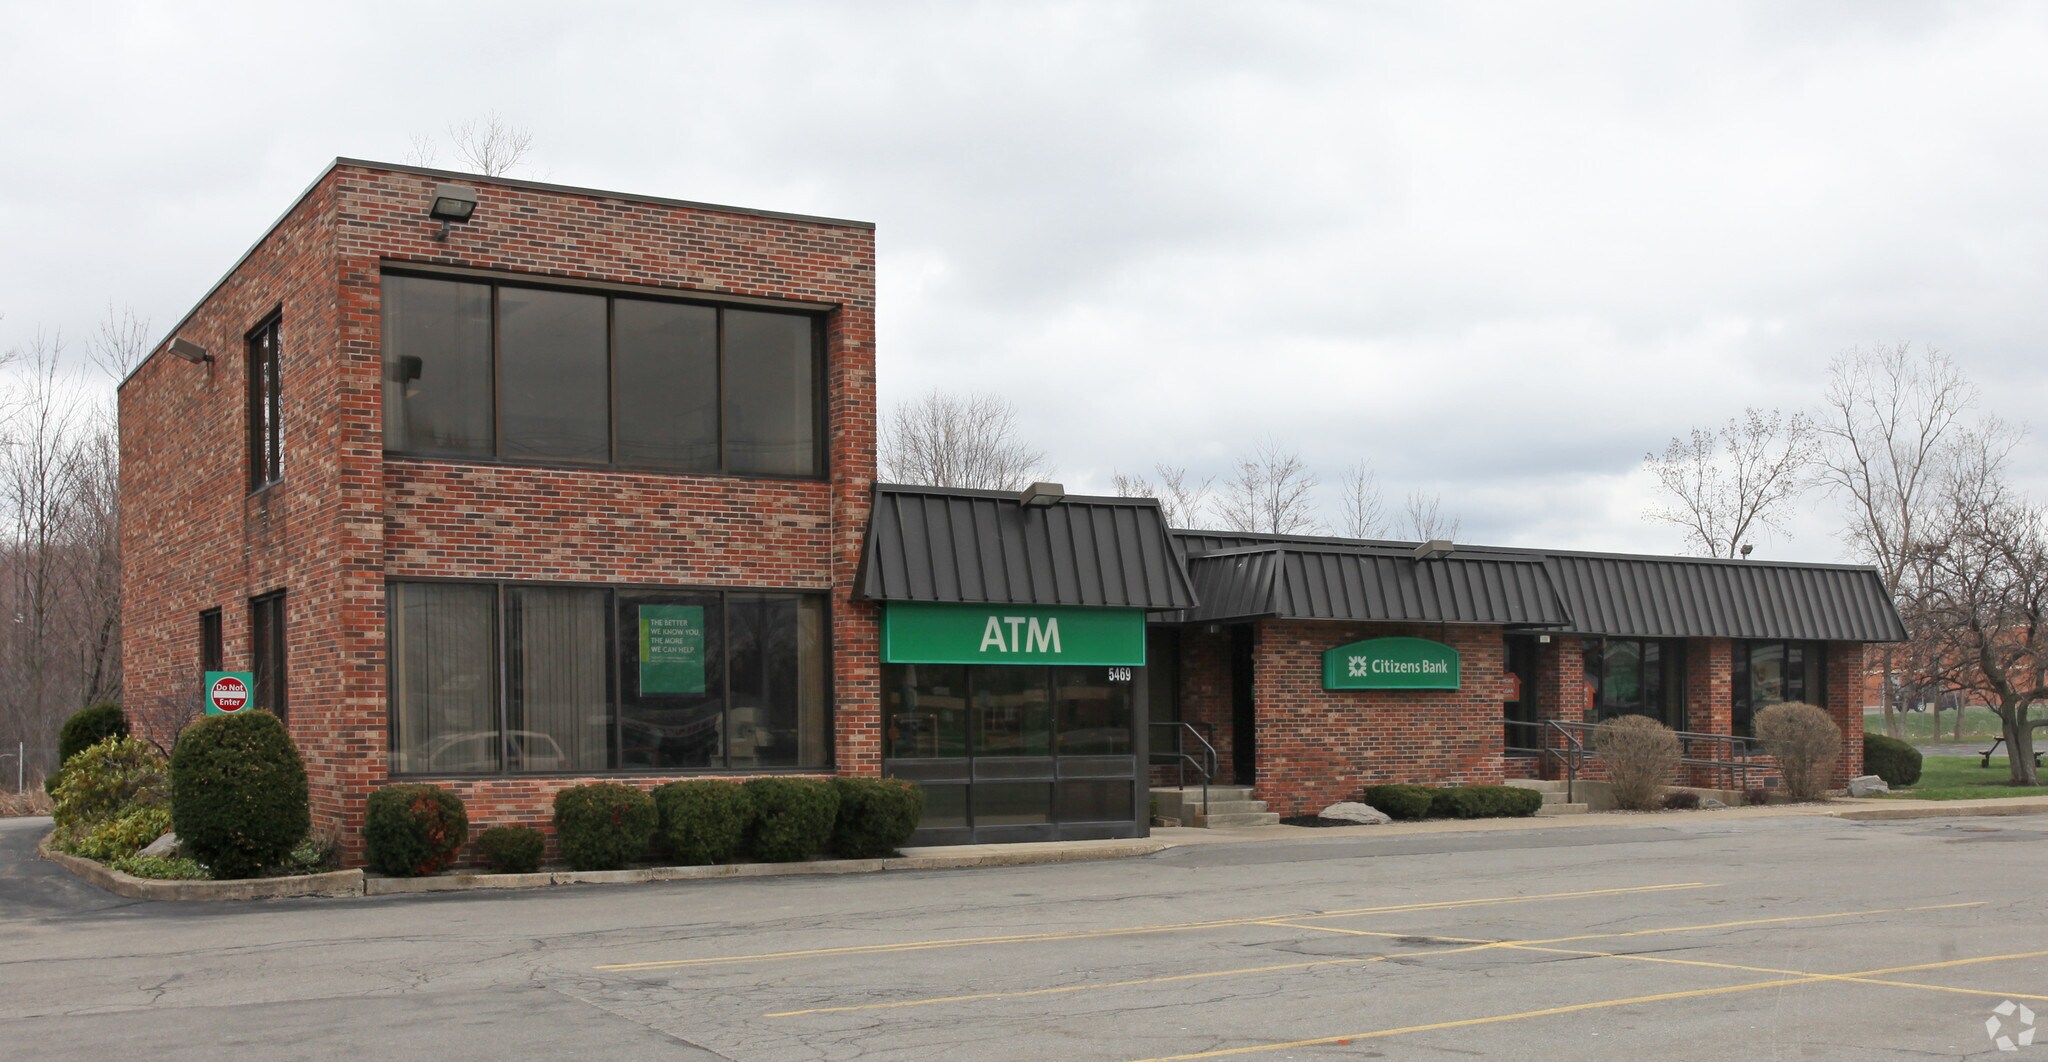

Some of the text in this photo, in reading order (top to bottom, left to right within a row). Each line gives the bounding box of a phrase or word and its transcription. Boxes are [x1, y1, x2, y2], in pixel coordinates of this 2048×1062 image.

[664, 619, 688, 627] BETTER
[662, 628, 684, 636] KNOW
[979, 615, 1062, 653] ATM
[664, 637, 684, 645] MORE
[1371, 659, 1448, 674] Citizens Bank
[1108, 667, 1131, 682] 5469
[216, 683, 244, 692] Do Not
[219, 698, 241, 706] Enter
